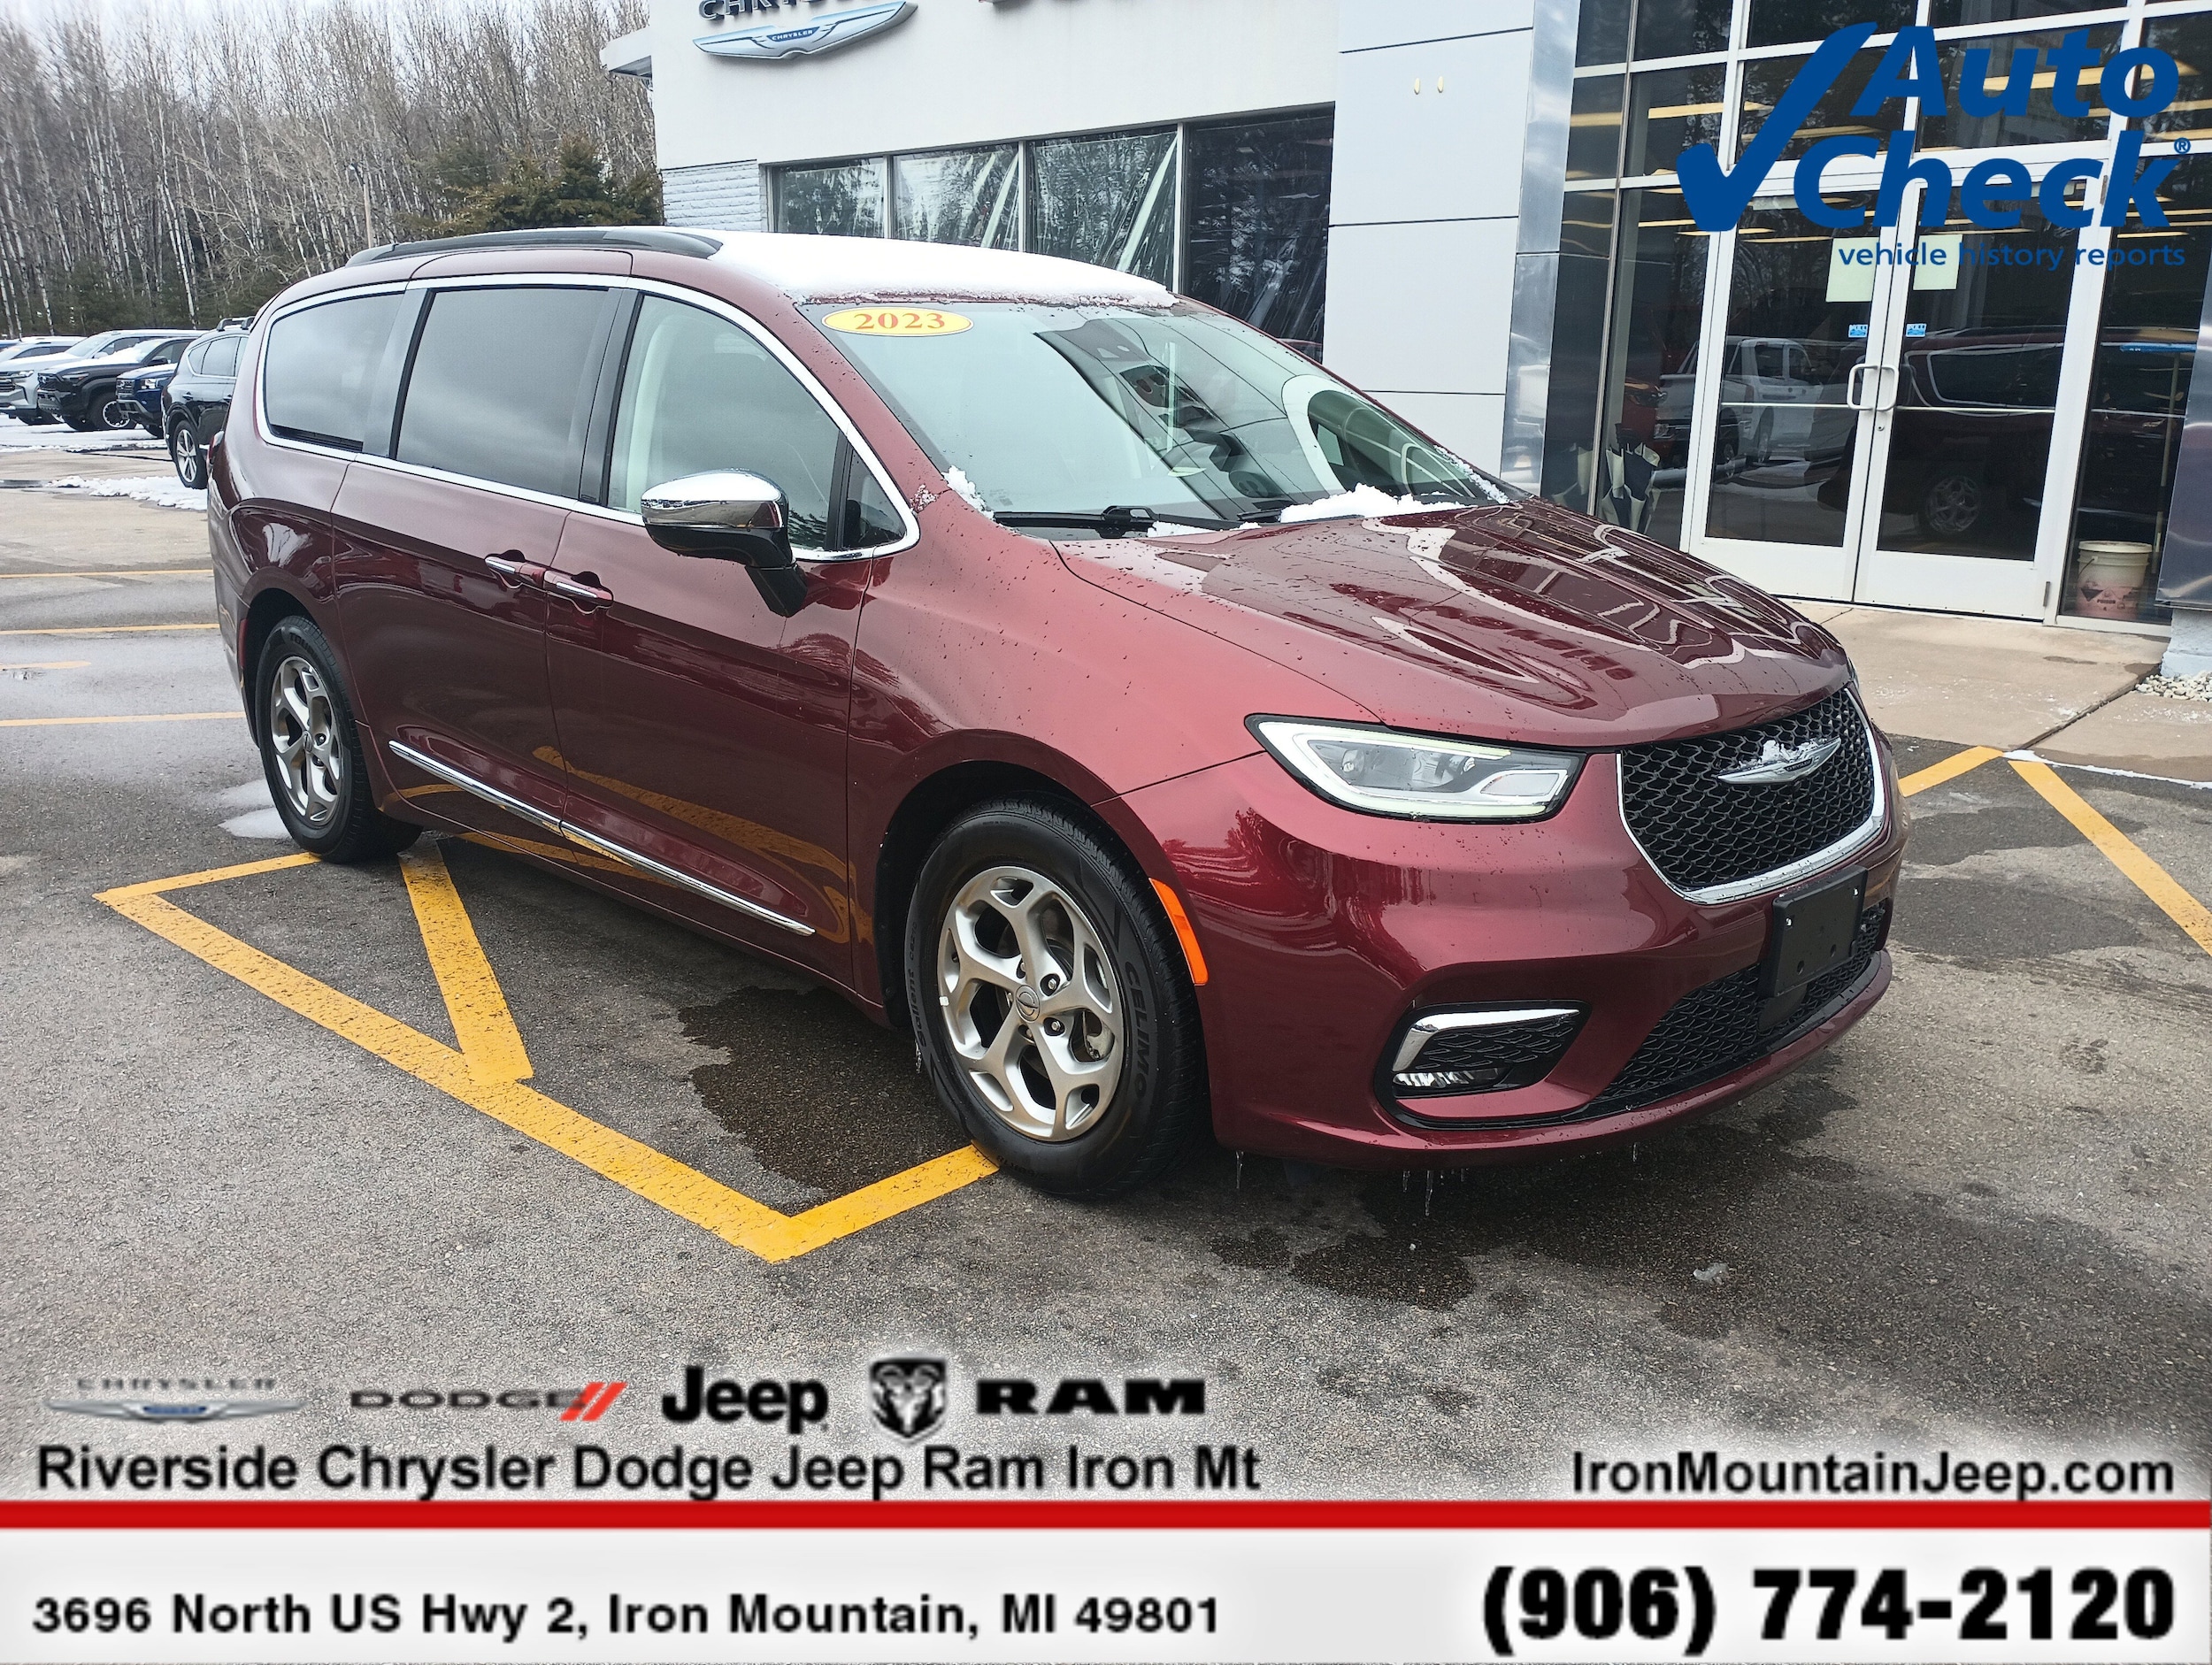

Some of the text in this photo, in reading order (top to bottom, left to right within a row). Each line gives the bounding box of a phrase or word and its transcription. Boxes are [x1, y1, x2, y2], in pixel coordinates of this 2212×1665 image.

[772, 29, 813, 41] CHRYSLER
[854, 312, 945, 330] 2023
[1125, 961, 1150, 1100] CELIMO
